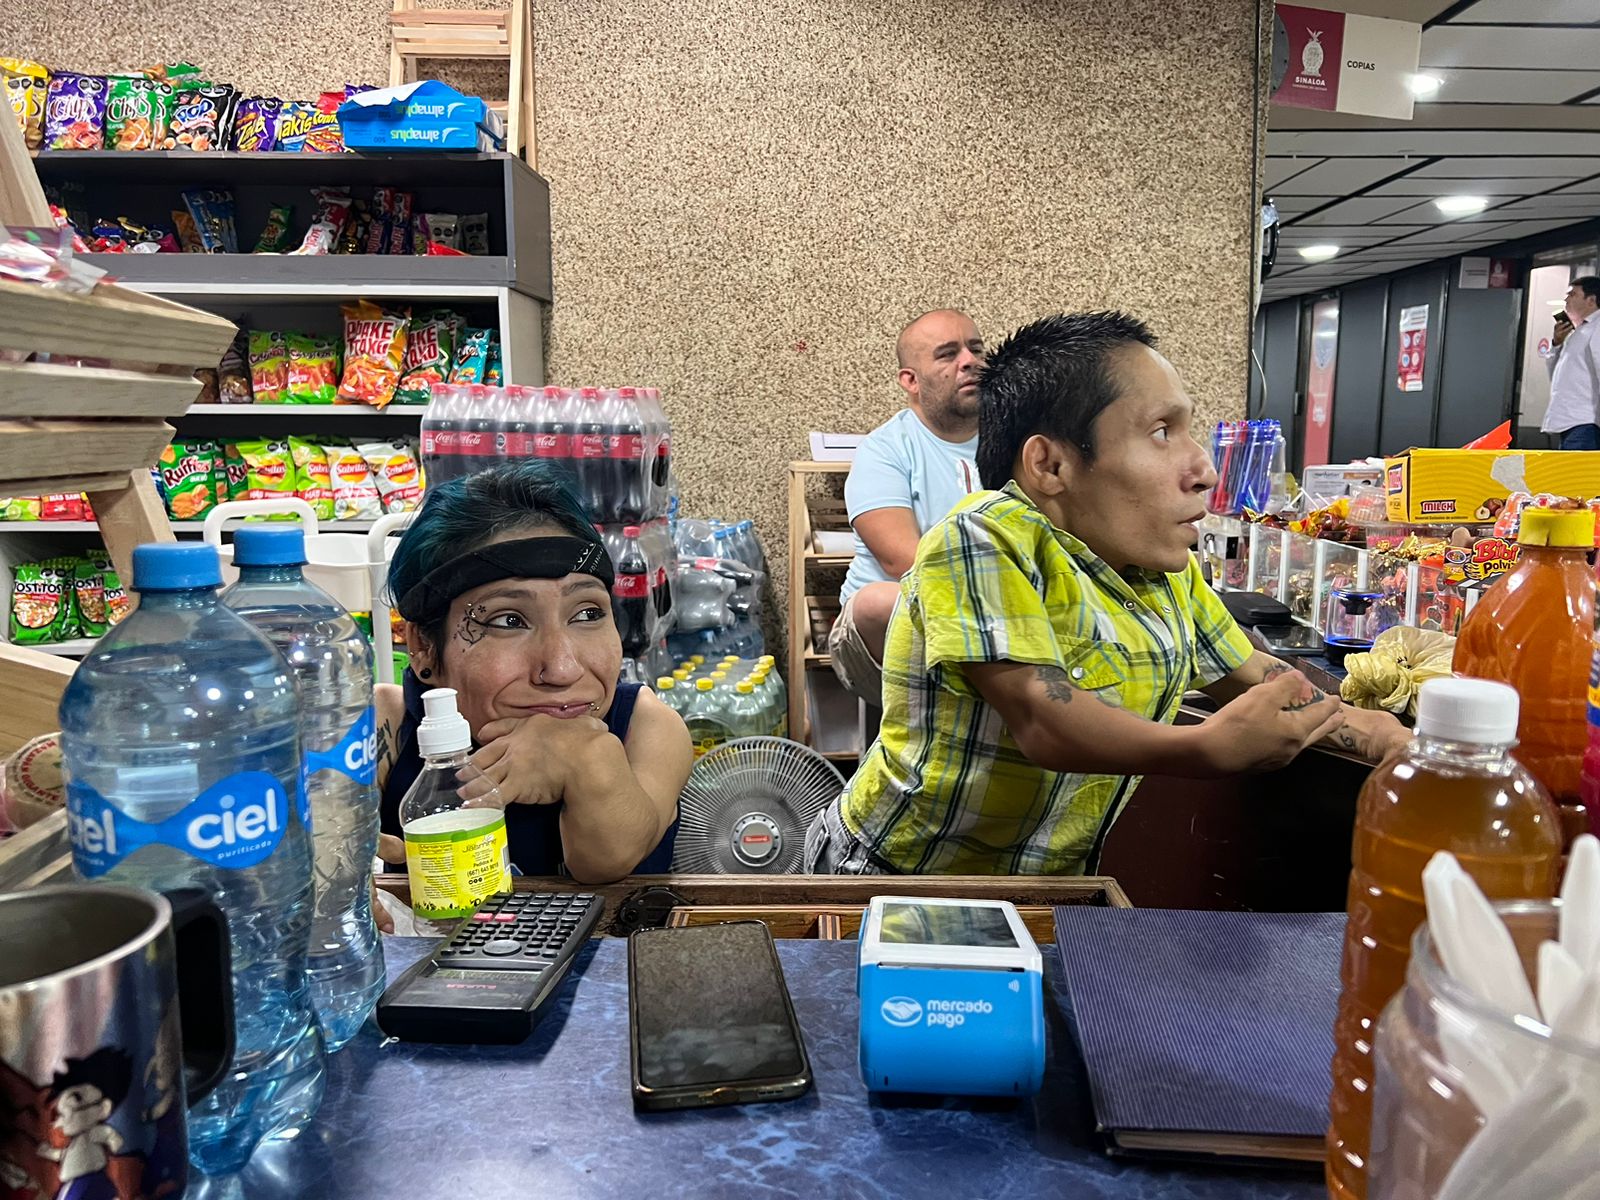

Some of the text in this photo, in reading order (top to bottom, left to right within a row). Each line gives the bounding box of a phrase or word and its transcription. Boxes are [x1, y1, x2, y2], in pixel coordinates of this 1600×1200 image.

[1347, 60, 1376, 71] COPIAS
[1295, 76, 1326, 86] SINALOA
[390, 127, 440, 143] almaplus
[408, 325, 437, 347] AKE
[308, 463, 329, 474] Sabri
[1423, 501, 1453, 511] MILCH
[1472, 540, 1519, 563] Bibi
[104, 587, 123, 599] TOST
[344, 724, 377, 771] cie
[186, 787, 278, 850] ciel
[217, 840, 273, 859] purificada
[927, 999, 993, 1014] mercado
[927, 1013, 965, 1029] pago
